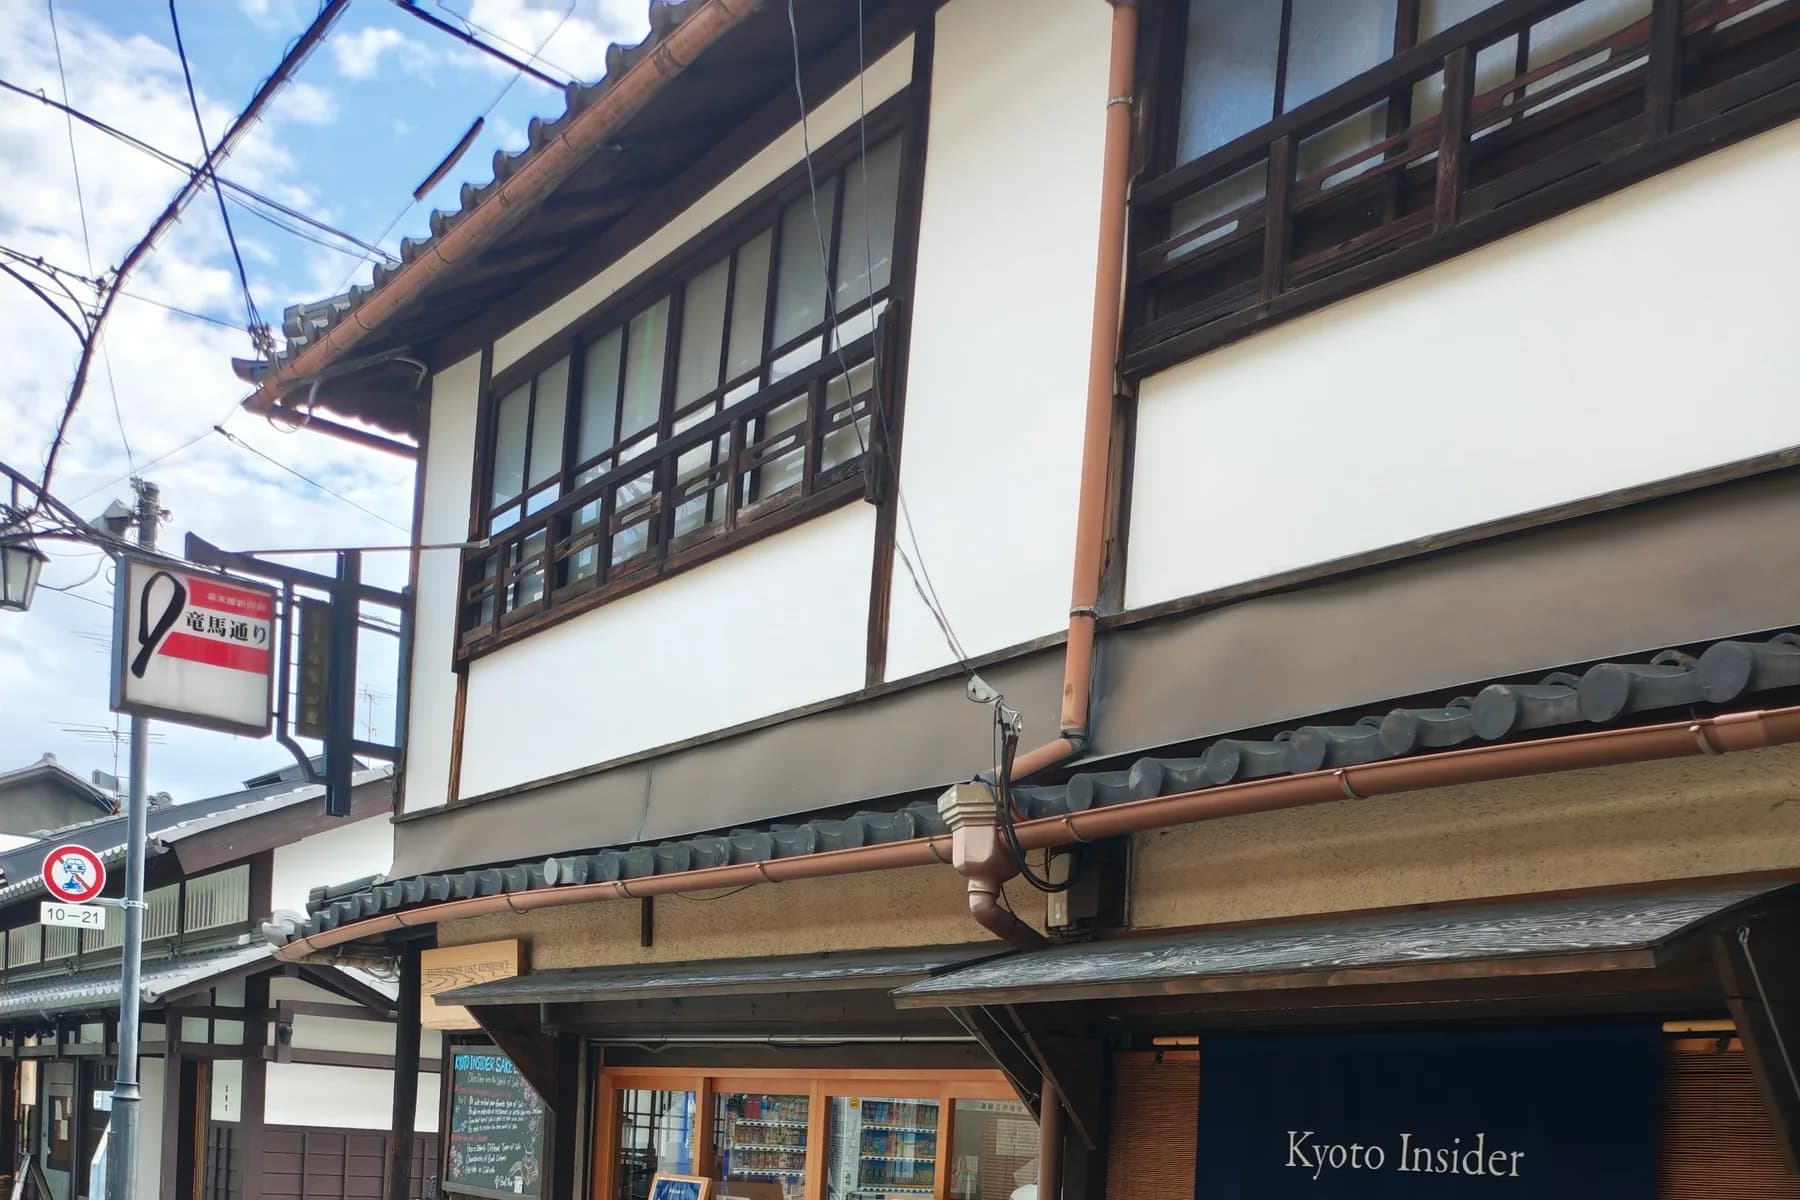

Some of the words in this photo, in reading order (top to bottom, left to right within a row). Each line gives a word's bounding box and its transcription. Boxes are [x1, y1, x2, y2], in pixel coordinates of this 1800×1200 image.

[186, 611, 266, 644] 竜馬通り
[1285, 1130, 1386, 1181] Kyoto
[1397, 1132, 1525, 1177] Insider
